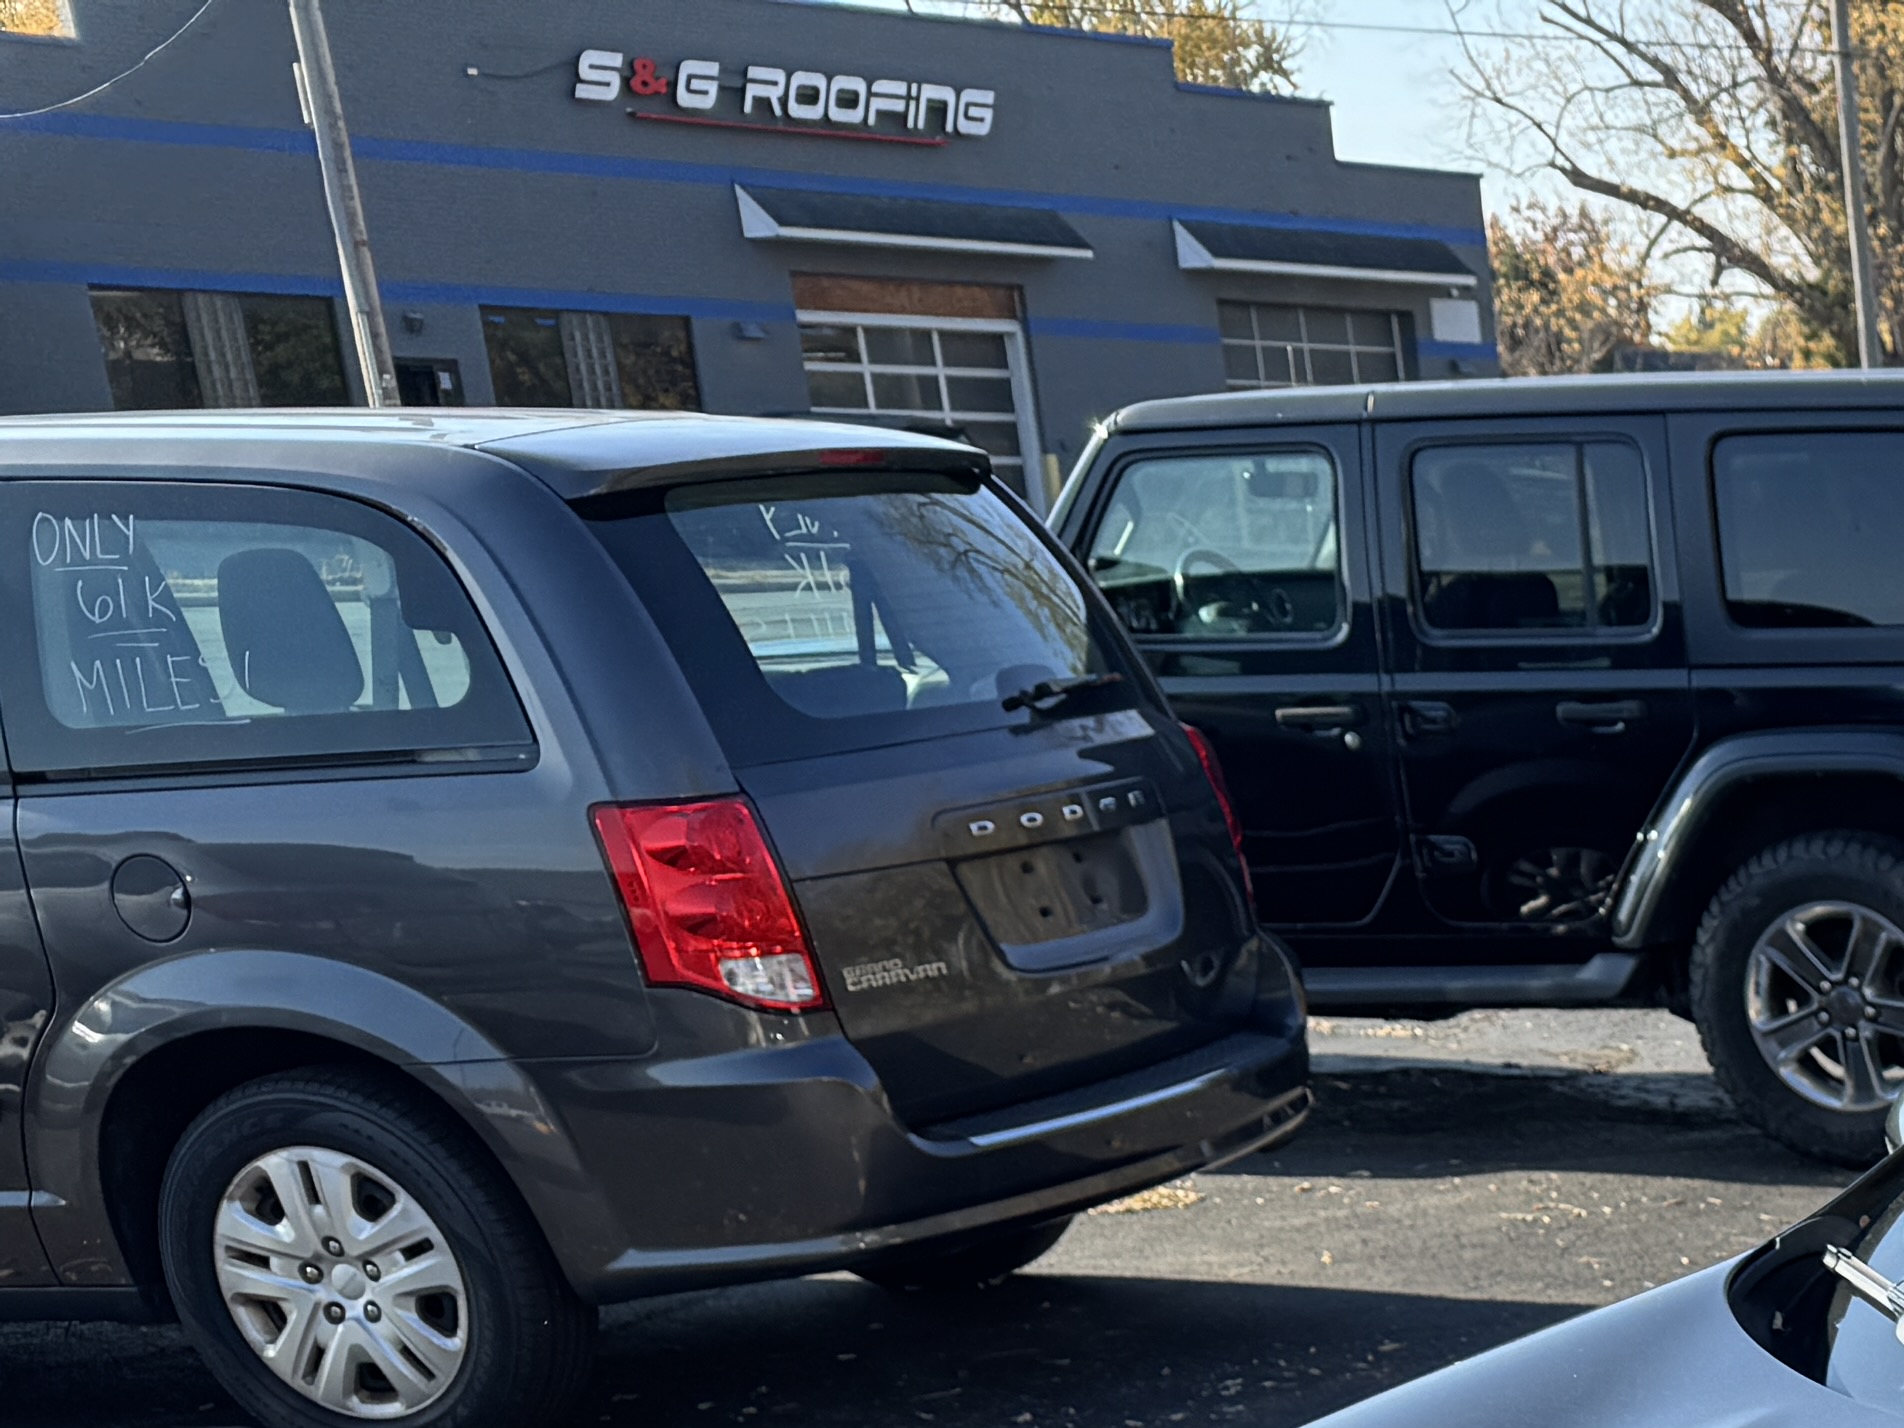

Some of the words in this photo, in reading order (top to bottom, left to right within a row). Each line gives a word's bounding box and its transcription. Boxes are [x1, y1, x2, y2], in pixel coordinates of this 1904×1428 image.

[574, 48, 720, 110] S&G
[32, 511, 135, 566] ONLY
[968, 790, 1145, 837] DODGE
